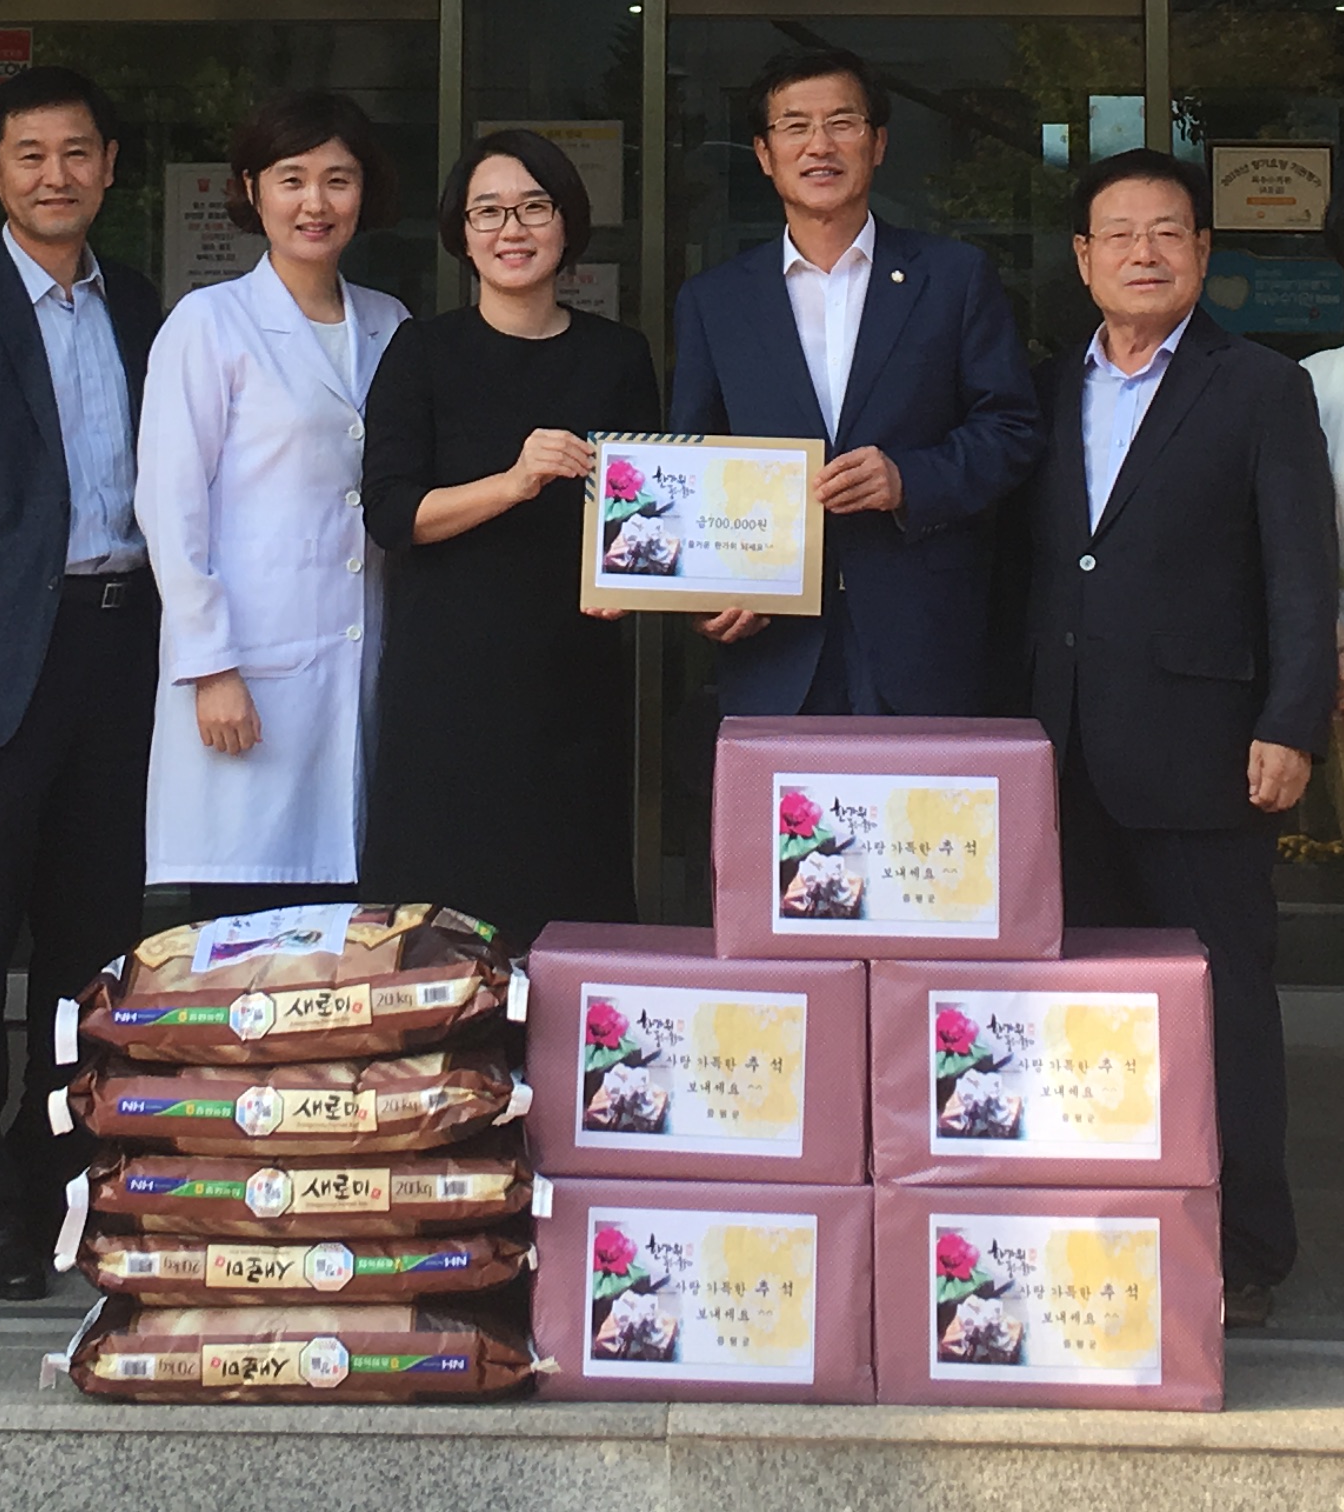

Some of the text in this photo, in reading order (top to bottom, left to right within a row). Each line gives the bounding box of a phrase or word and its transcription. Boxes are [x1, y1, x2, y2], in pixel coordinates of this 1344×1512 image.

[861, 840, 886, 855] 사랑
[881, 866, 936, 881] 보내세요
[285, 992, 351, 1017] 새로미
[114, 1011, 138, 1023] NH
[666, 1054, 691, 1070] 사랑
[1019, 1058, 1044, 1073] 사랑
[686, 1080, 739, 1096] 보내세요
[1040, 1084, 1094, 1099] 보내세요
[121, 1100, 145, 1112] NH
[130, 1179, 154, 1191] NH
[302, 1173, 370, 1200] 새로미
[444, 1256, 468, 1267] NH
[225, 1256, 294, 1283] 새로미
[676, 1280, 701, 1296] 사랑
[1020, 1284, 1045, 1300] 사랑
[696, 1307, 750, 1322] 보내세요
[1042, 1311, 1096, 1326] 보내세요
